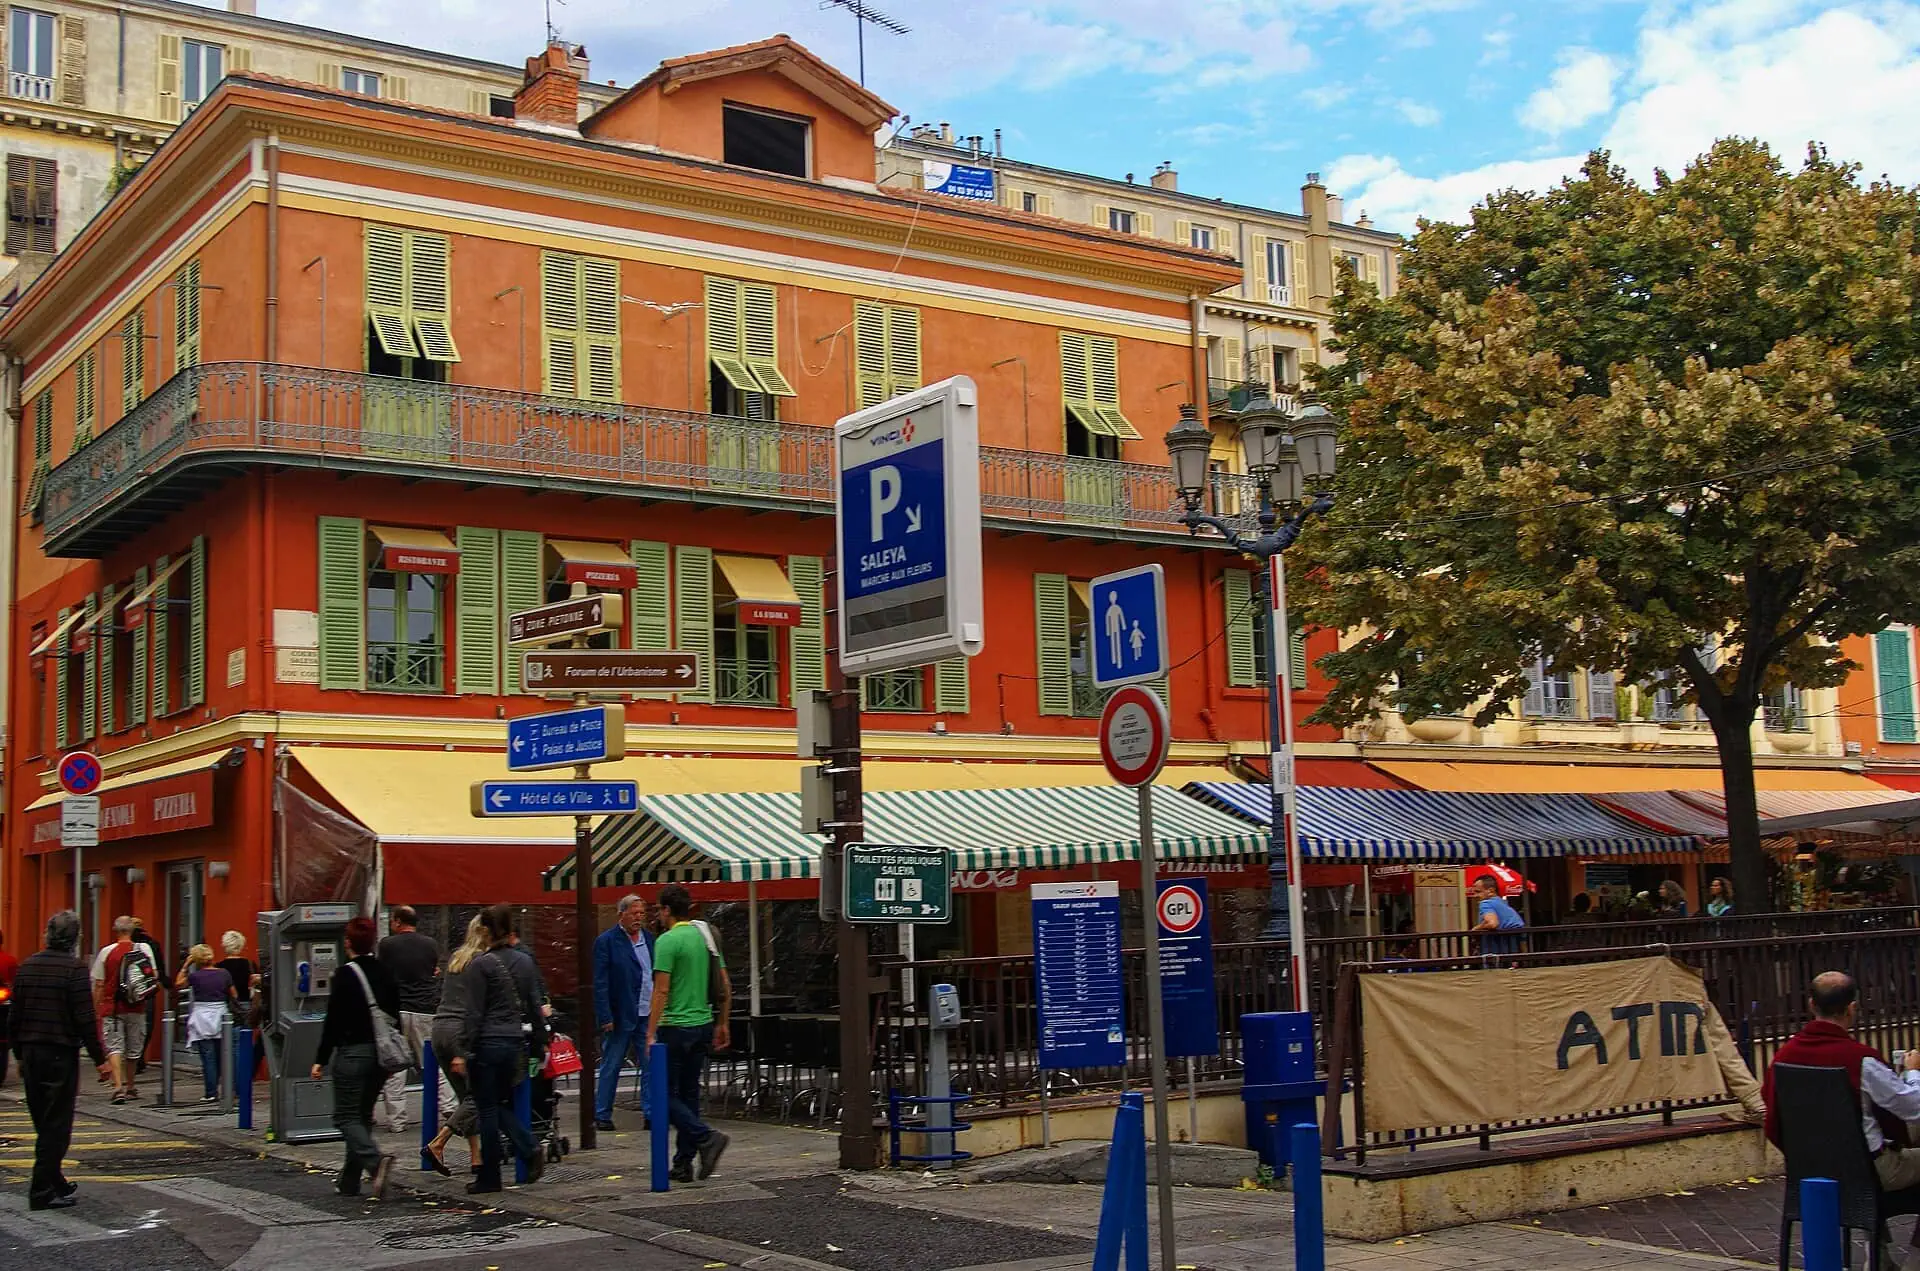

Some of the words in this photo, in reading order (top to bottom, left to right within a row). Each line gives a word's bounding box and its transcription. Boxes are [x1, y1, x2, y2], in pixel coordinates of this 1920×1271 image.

[869, 464, 902, 543] P
[861, 545, 907, 571] SALEYA
[907, 562, 932, 576] FLEURS
[526, 617, 546, 631] ZONE
[564, 666, 597, 677] Forum
[598, 666, 610, 677] de
[542, 725, 568, 737] Bureau
[569, 721, 579, 733] de
[542, 743, 564, 756] Palais
[565, 741, 575, 753] de
[576, 739, 602, 751] Justice
[520, 791, 551, 804] Hôtel
[552, 792, 567, 804] de
[569, 791, 593, 804] Ville
[853, 855, 896, 864] TOILETTES
[897, 856, 943, 866] PUBLIQUES
[1155, 861, 1244, 873] PIZZERIA
[881, 865, 915, 876] SALEYA
[1167, 903, 1192, 915] GPL
[1557, 1001, 1708, 1070] ATM
